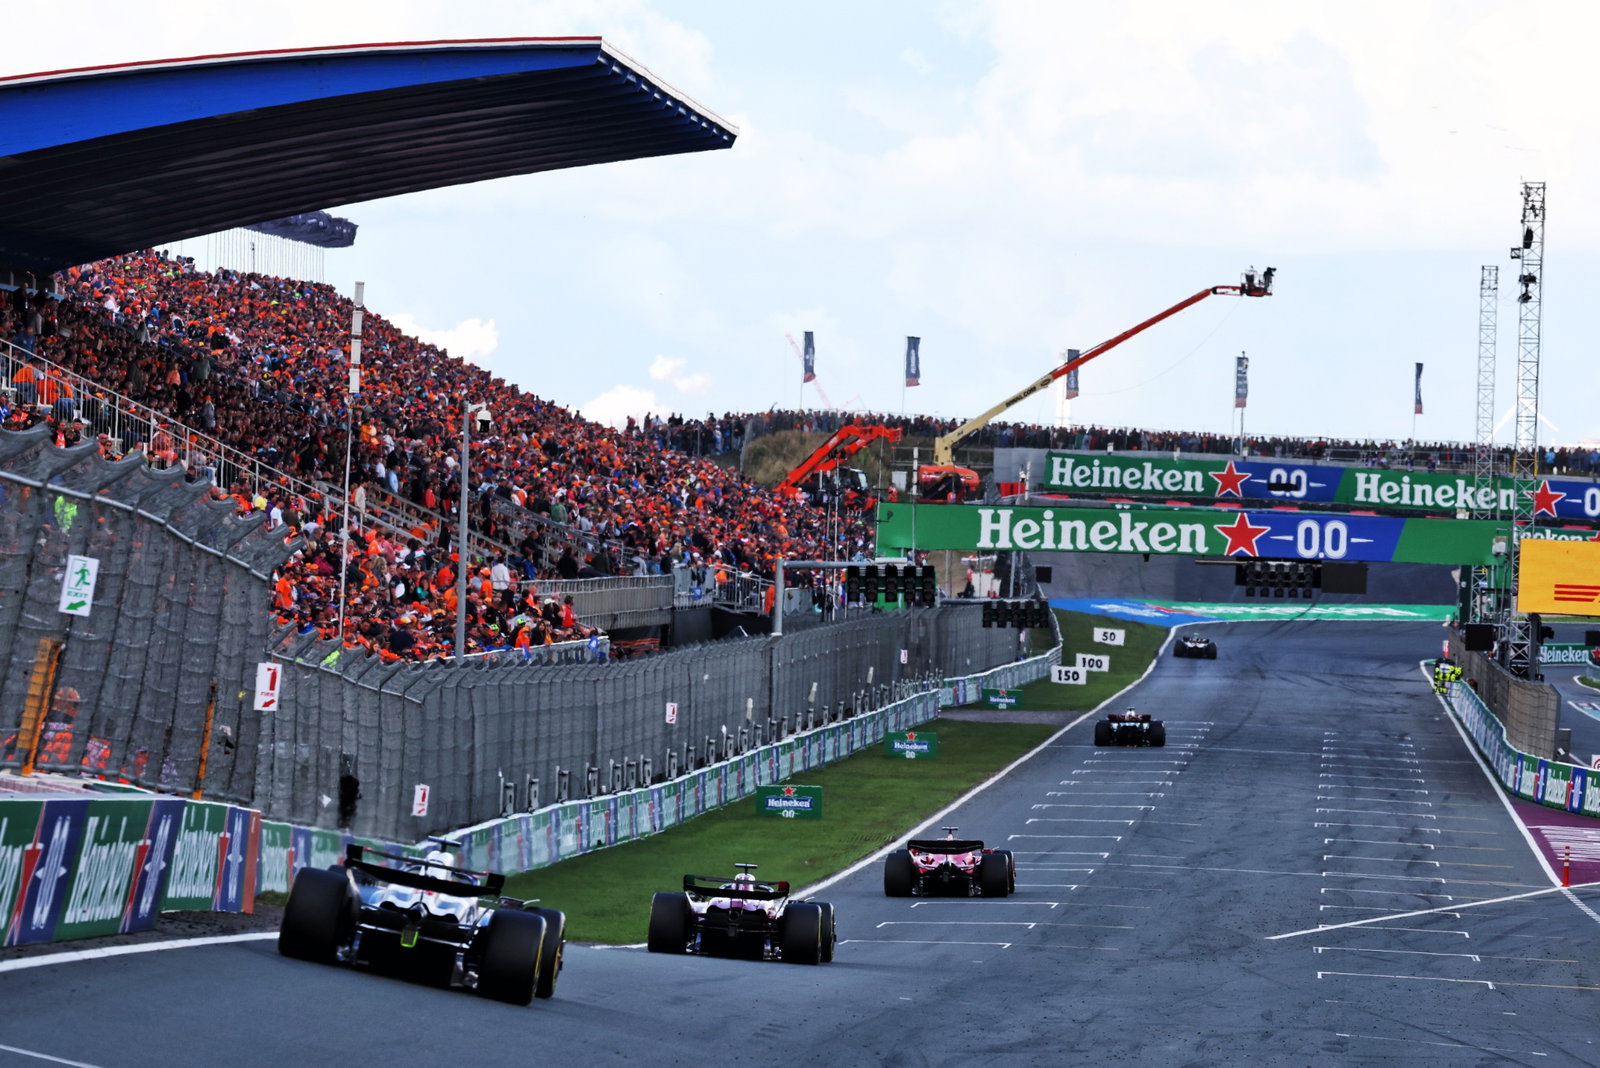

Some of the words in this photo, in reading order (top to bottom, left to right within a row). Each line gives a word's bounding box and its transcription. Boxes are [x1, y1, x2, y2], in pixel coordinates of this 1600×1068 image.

[1050, 456, 1205, 492] Heineken
[1354, 472, 1518, 510] Heineken
[976, 509, 1209, 553] Heineken
[1102, 631, 1116, 642] 50
[1082, 657, 1103, 669] 100
[1058, 669, 1080, 682] 150
[768, 798, 810, 808] Heineken
